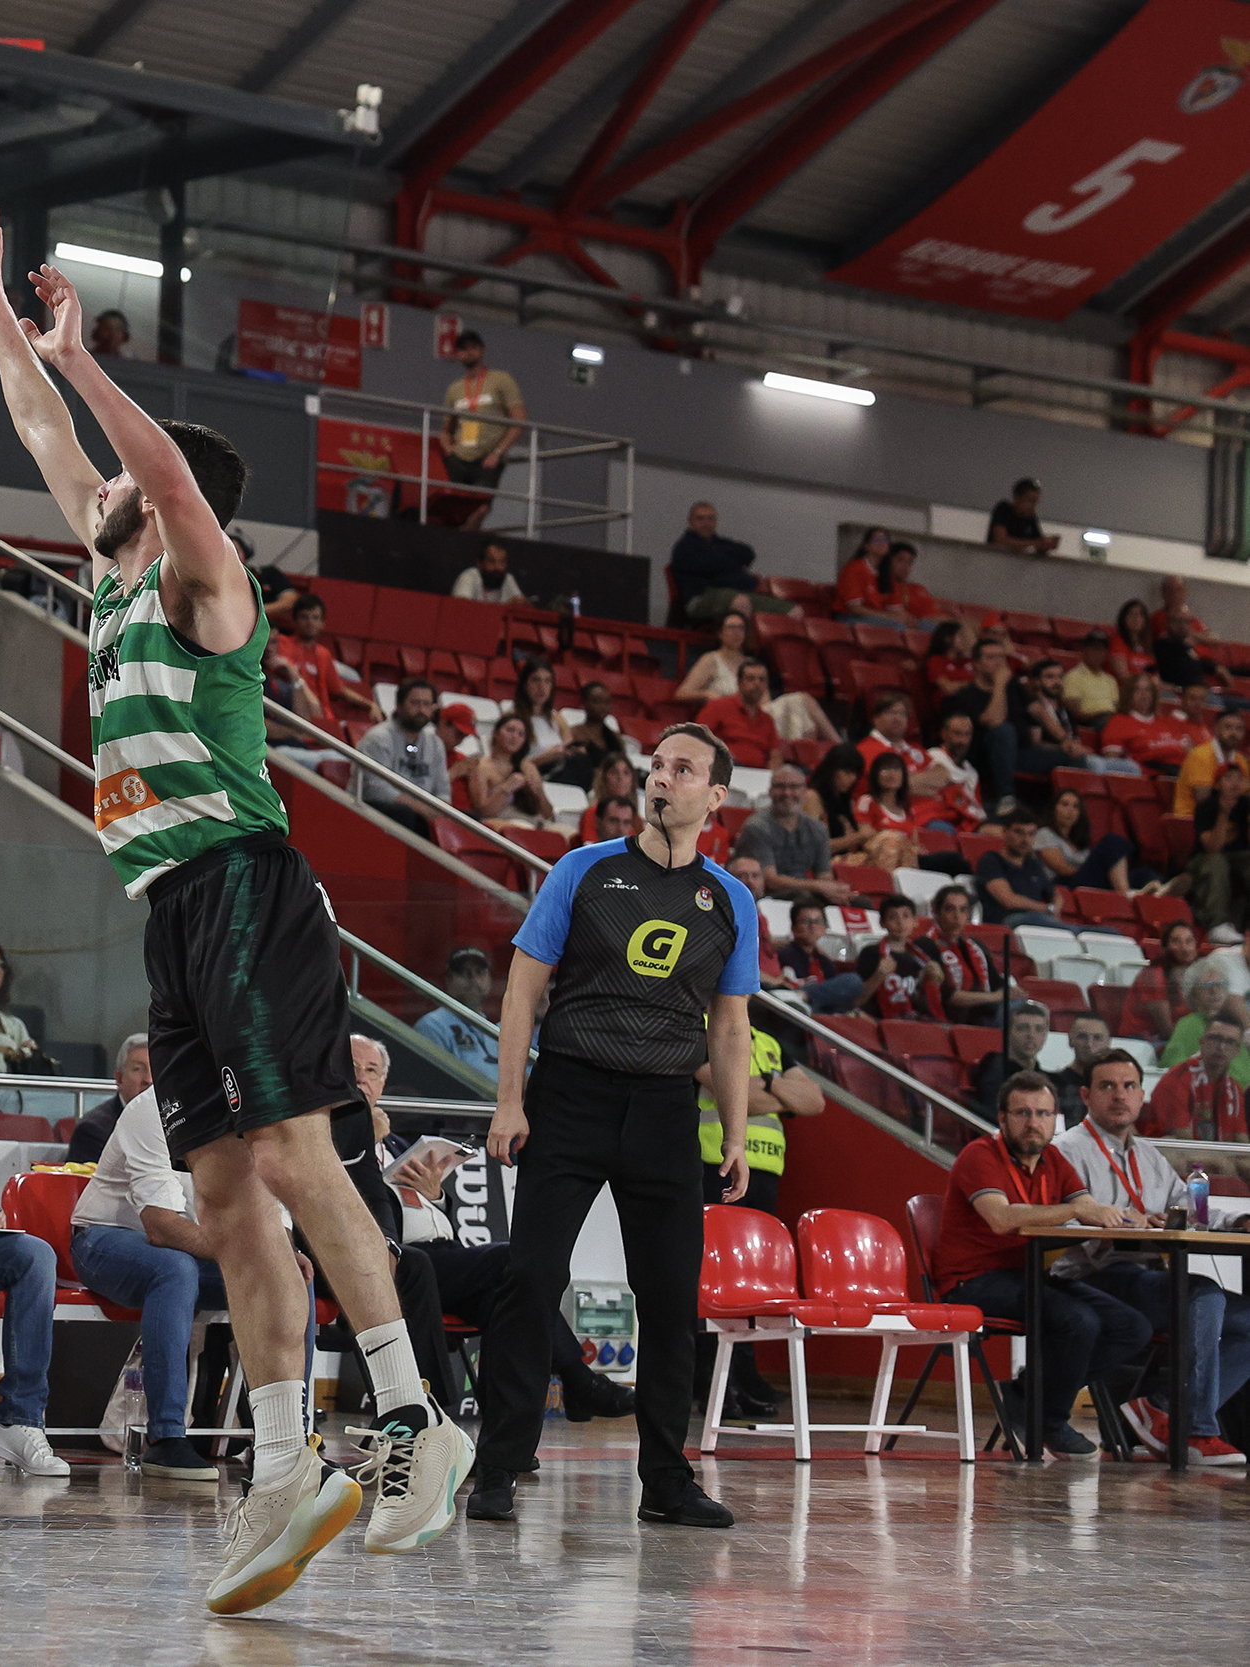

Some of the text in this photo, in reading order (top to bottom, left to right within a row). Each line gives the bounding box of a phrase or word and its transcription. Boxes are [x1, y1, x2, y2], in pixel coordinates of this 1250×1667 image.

[1022, 138, 1185, 235] 5
[603, 883, 639, 891] DHIKA
[642, 928, 677, 960] G
[632, 959, 670, 973] GOLDCAR
